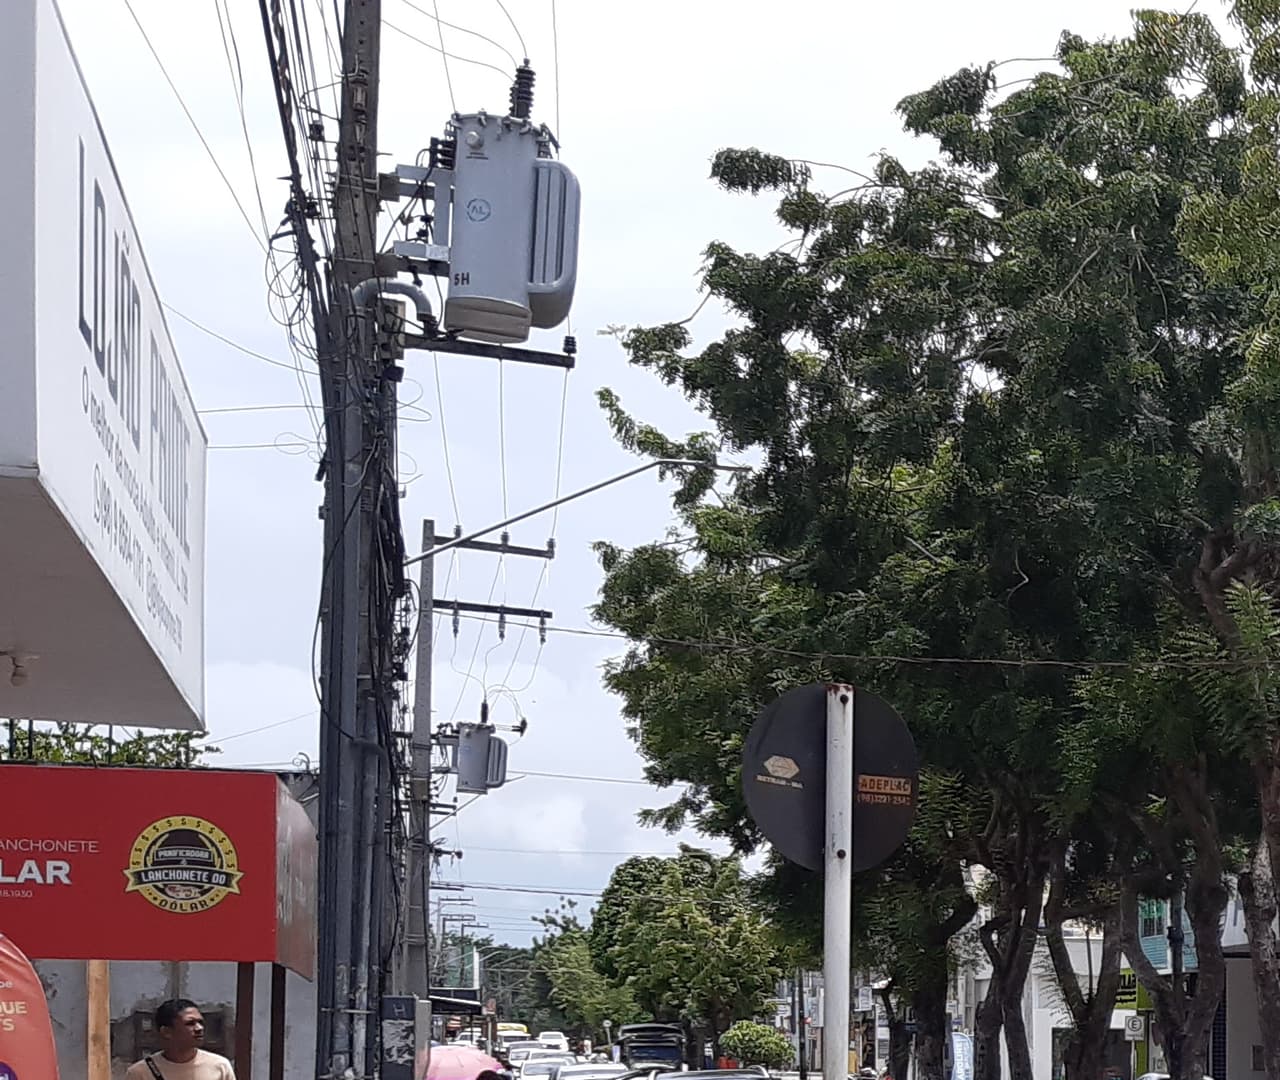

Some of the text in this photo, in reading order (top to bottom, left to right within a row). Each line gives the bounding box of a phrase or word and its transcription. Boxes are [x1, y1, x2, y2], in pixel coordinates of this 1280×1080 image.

[79, 134, 141, 454] LOJÃO
[150, 328, 190, 561] PRIME
[141, 869, 209, 883] LANCHONETE
